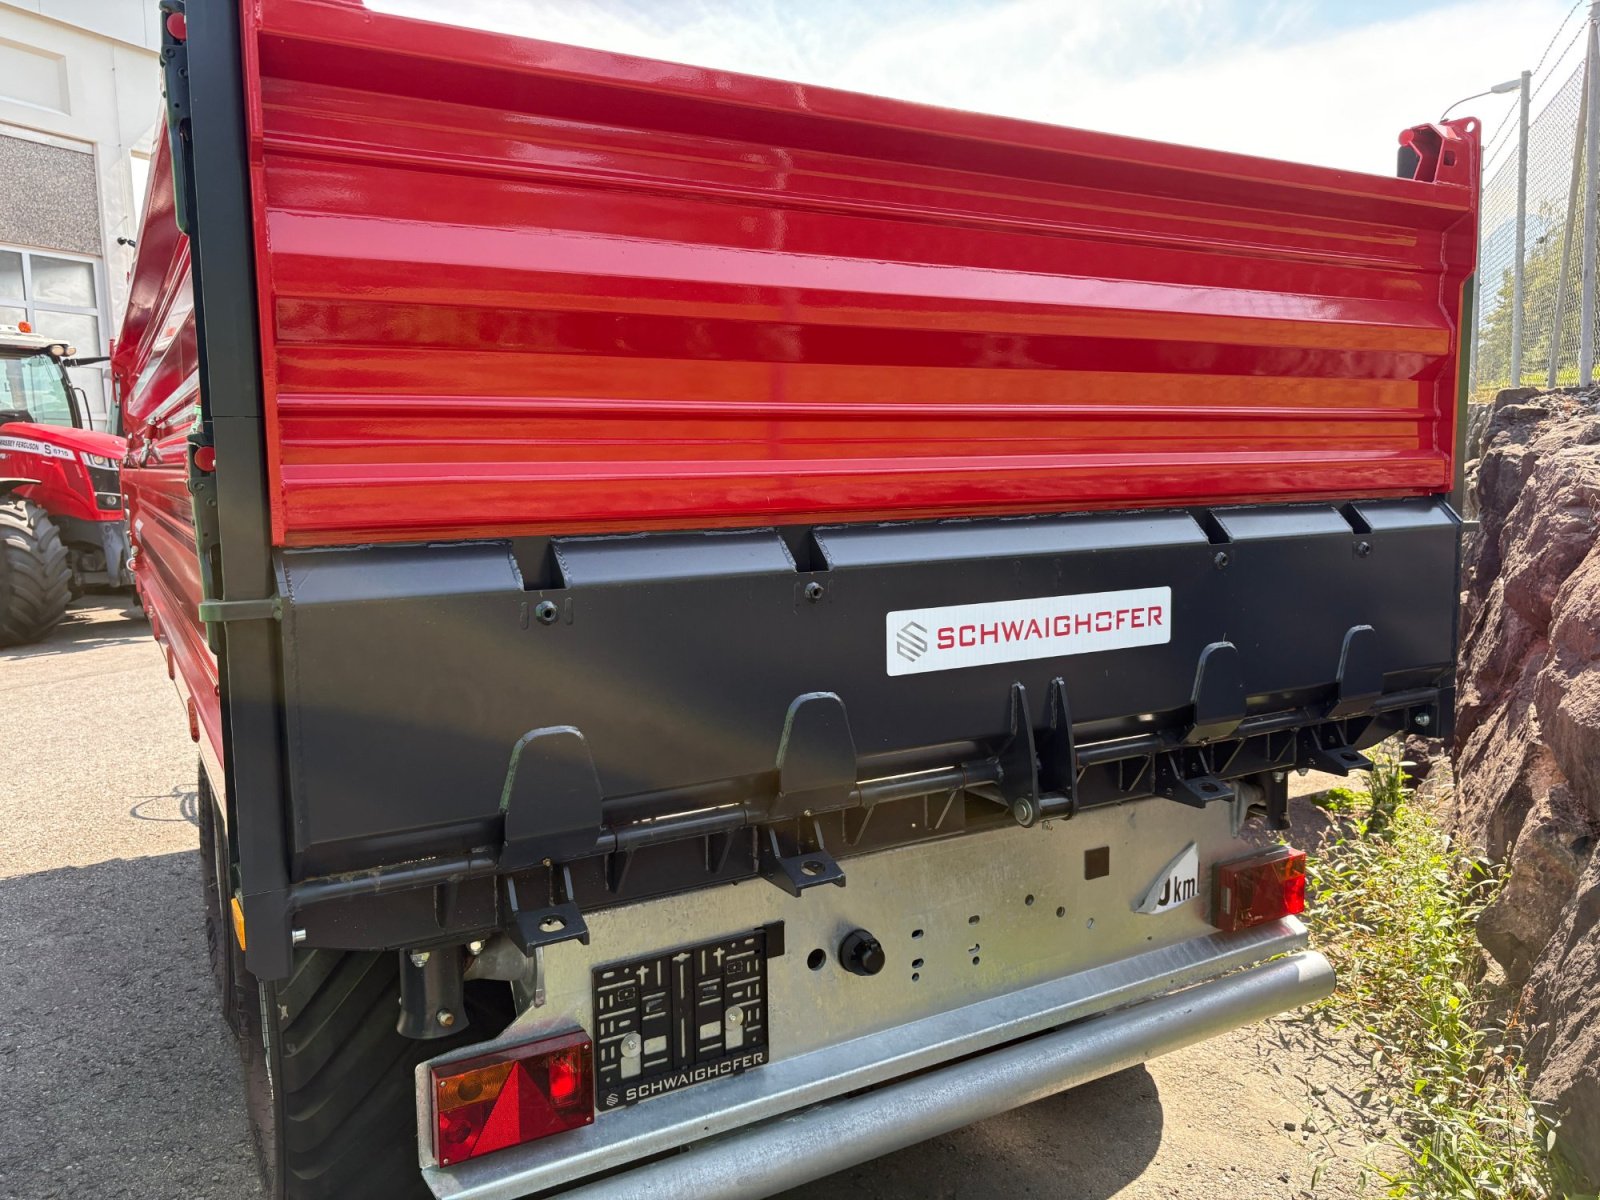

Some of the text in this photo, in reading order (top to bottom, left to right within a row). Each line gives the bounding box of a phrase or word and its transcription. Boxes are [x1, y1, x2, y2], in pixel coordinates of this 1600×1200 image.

[16, 441, 39, 450] FERGUSON
[44, 444, 51, 454] S
[936, 605, 1163, 650] SCHWAIGHOFER
[626, 1052, 764, 1101] SCHWAIGHOFER
